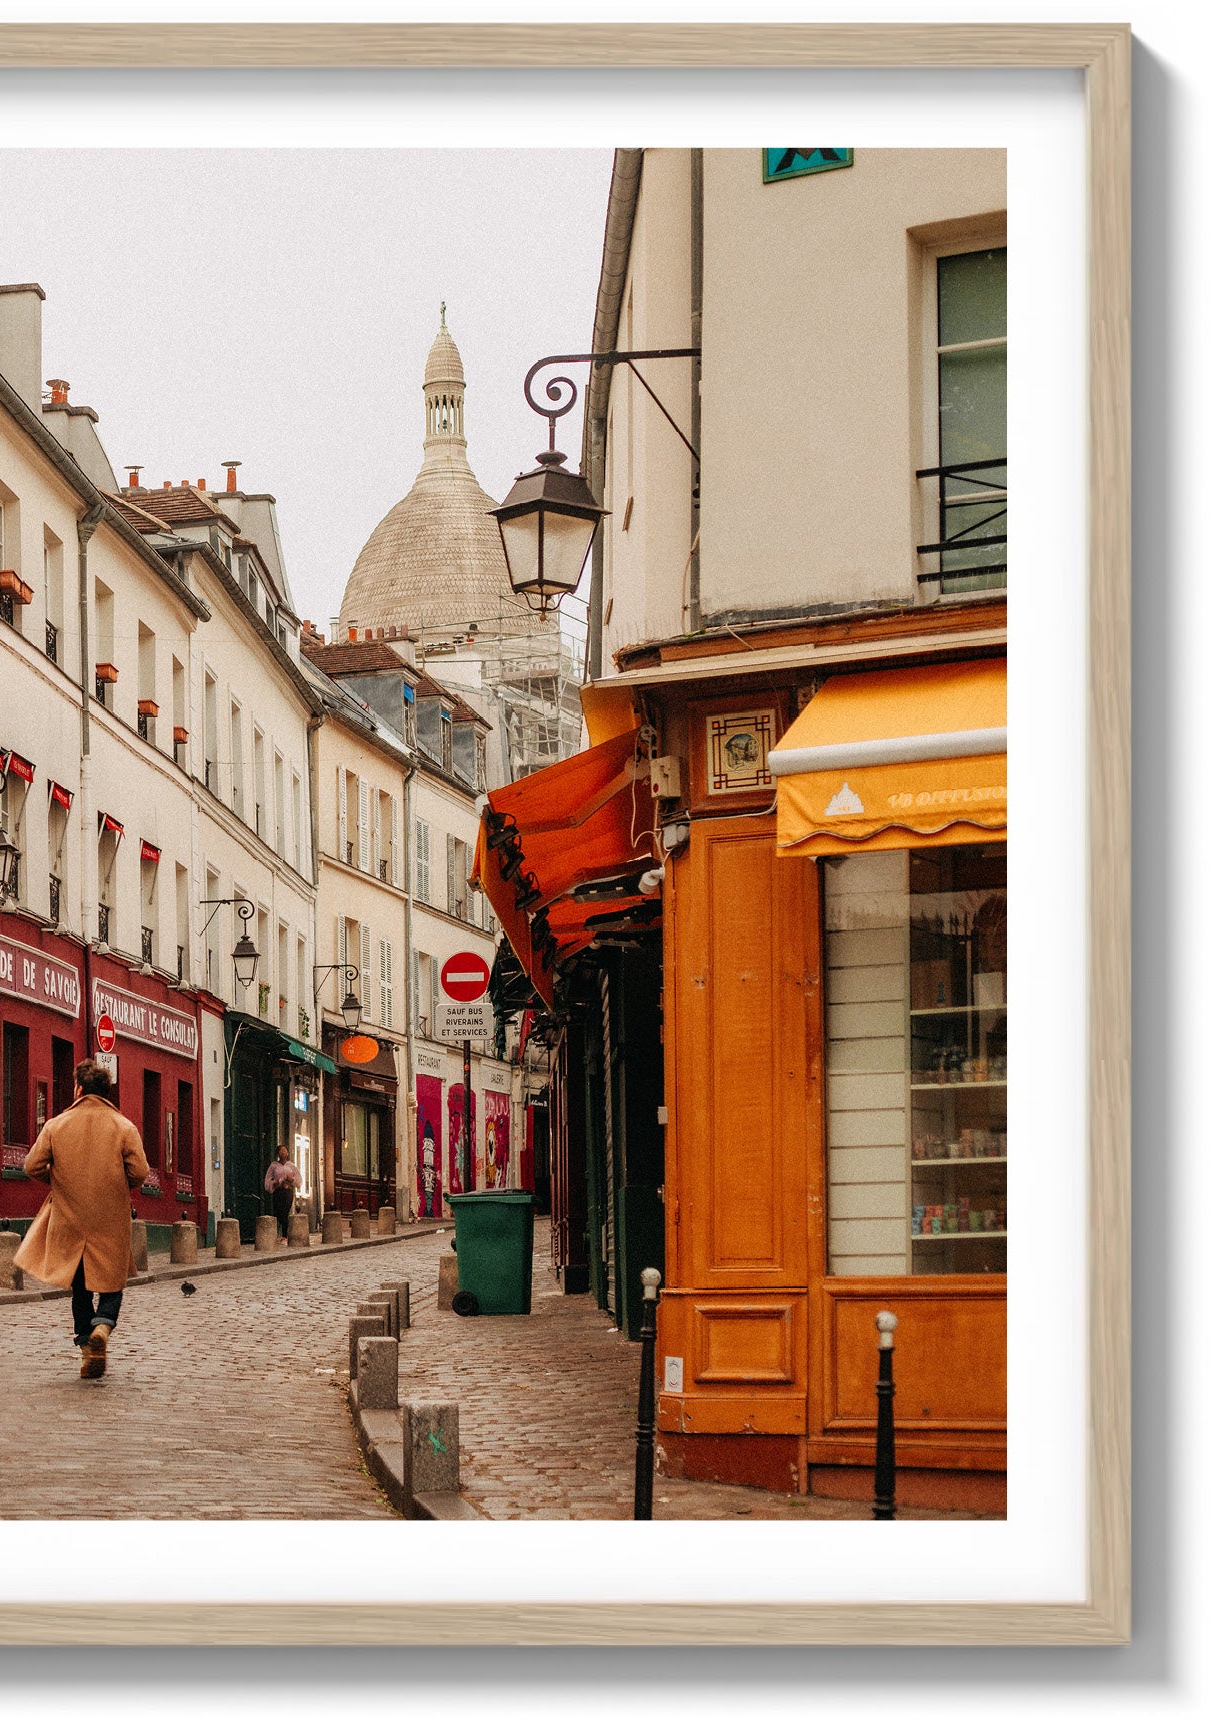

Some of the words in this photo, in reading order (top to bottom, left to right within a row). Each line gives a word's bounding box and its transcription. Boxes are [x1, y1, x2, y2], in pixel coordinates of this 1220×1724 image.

[22, 959, 36, 991] DE
[43, 967, 78, 1008] SAVOIE
[94, 989, 147, 1031] RESTAURANT
[148, 1009, 158, 1036] LE
[160, 1014, 196, 1049] CONSULAT
[445, 1018, 484, 1026] RIVERAINS
[453, 1028, 488, 1036] SERVICES
[101, 1055, 113, 1063] SAUF
